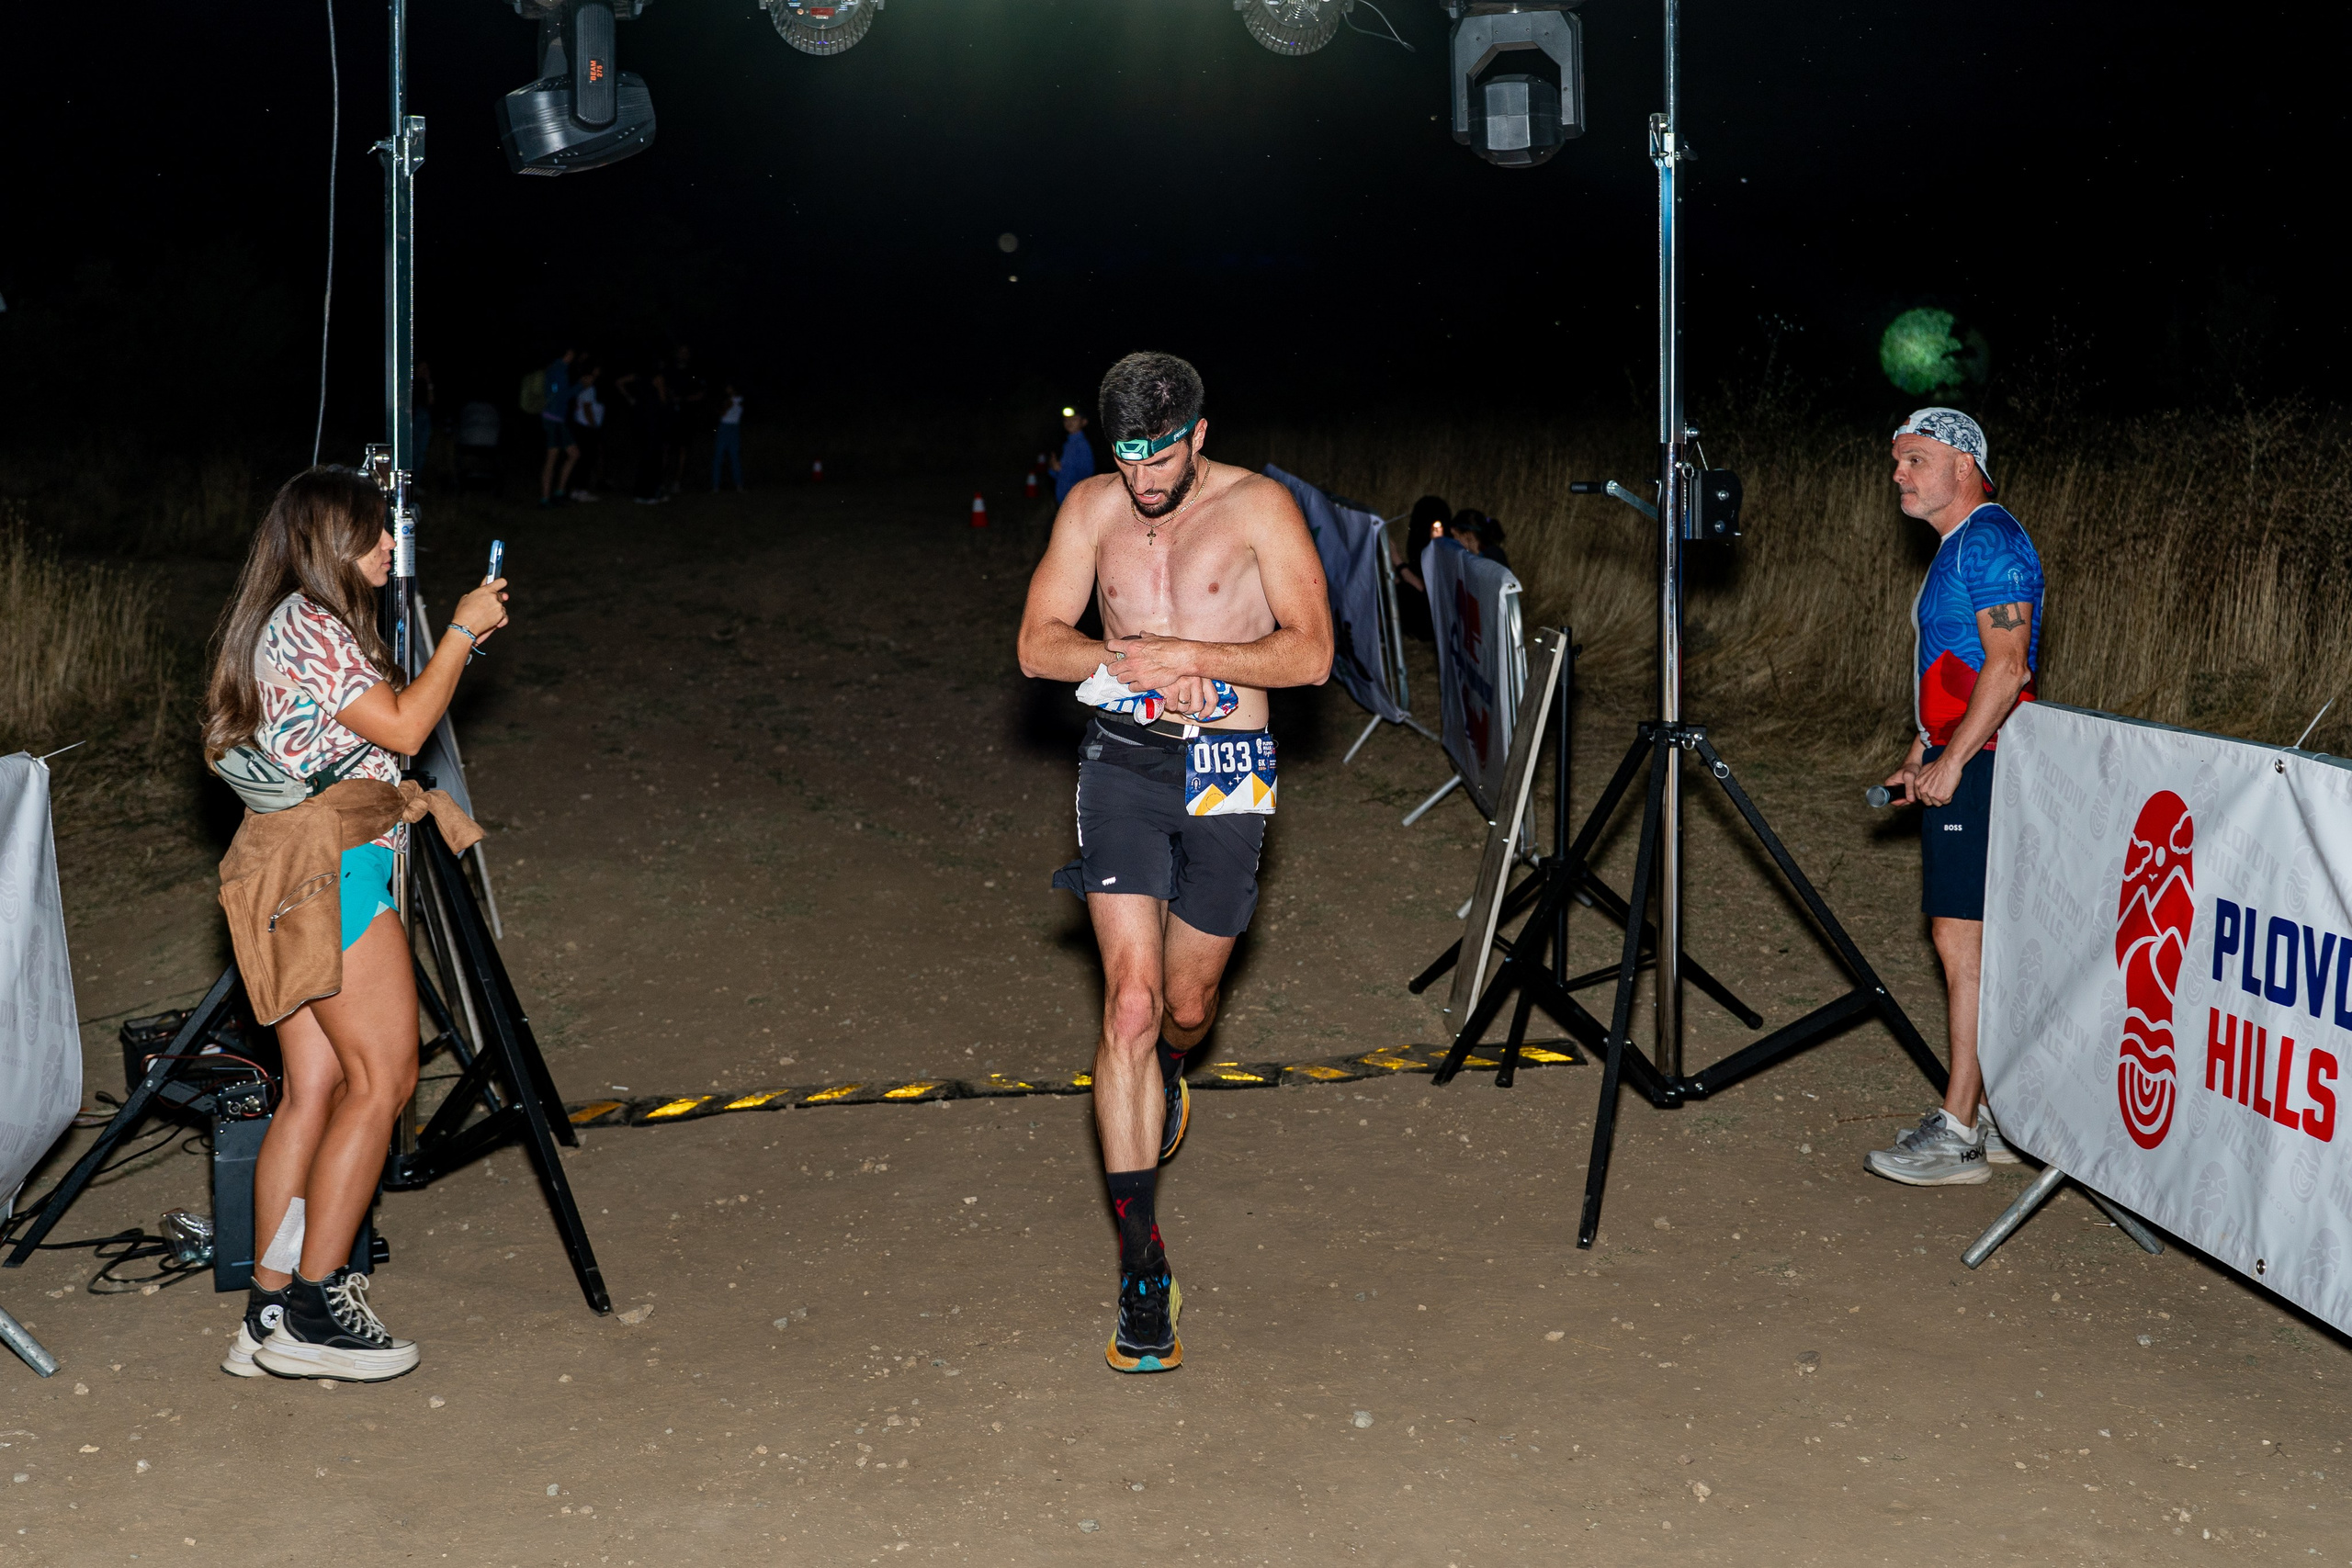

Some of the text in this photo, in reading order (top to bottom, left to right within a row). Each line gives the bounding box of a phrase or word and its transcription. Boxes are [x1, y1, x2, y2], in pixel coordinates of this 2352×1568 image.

[1194, 741, 1252, 773] 0133
[2036, 750, 2088, 814] PLOVDIV
[2028, 778, 2064, 828] HILLS
[2205, 1007, 2338, 1143] HILLS
